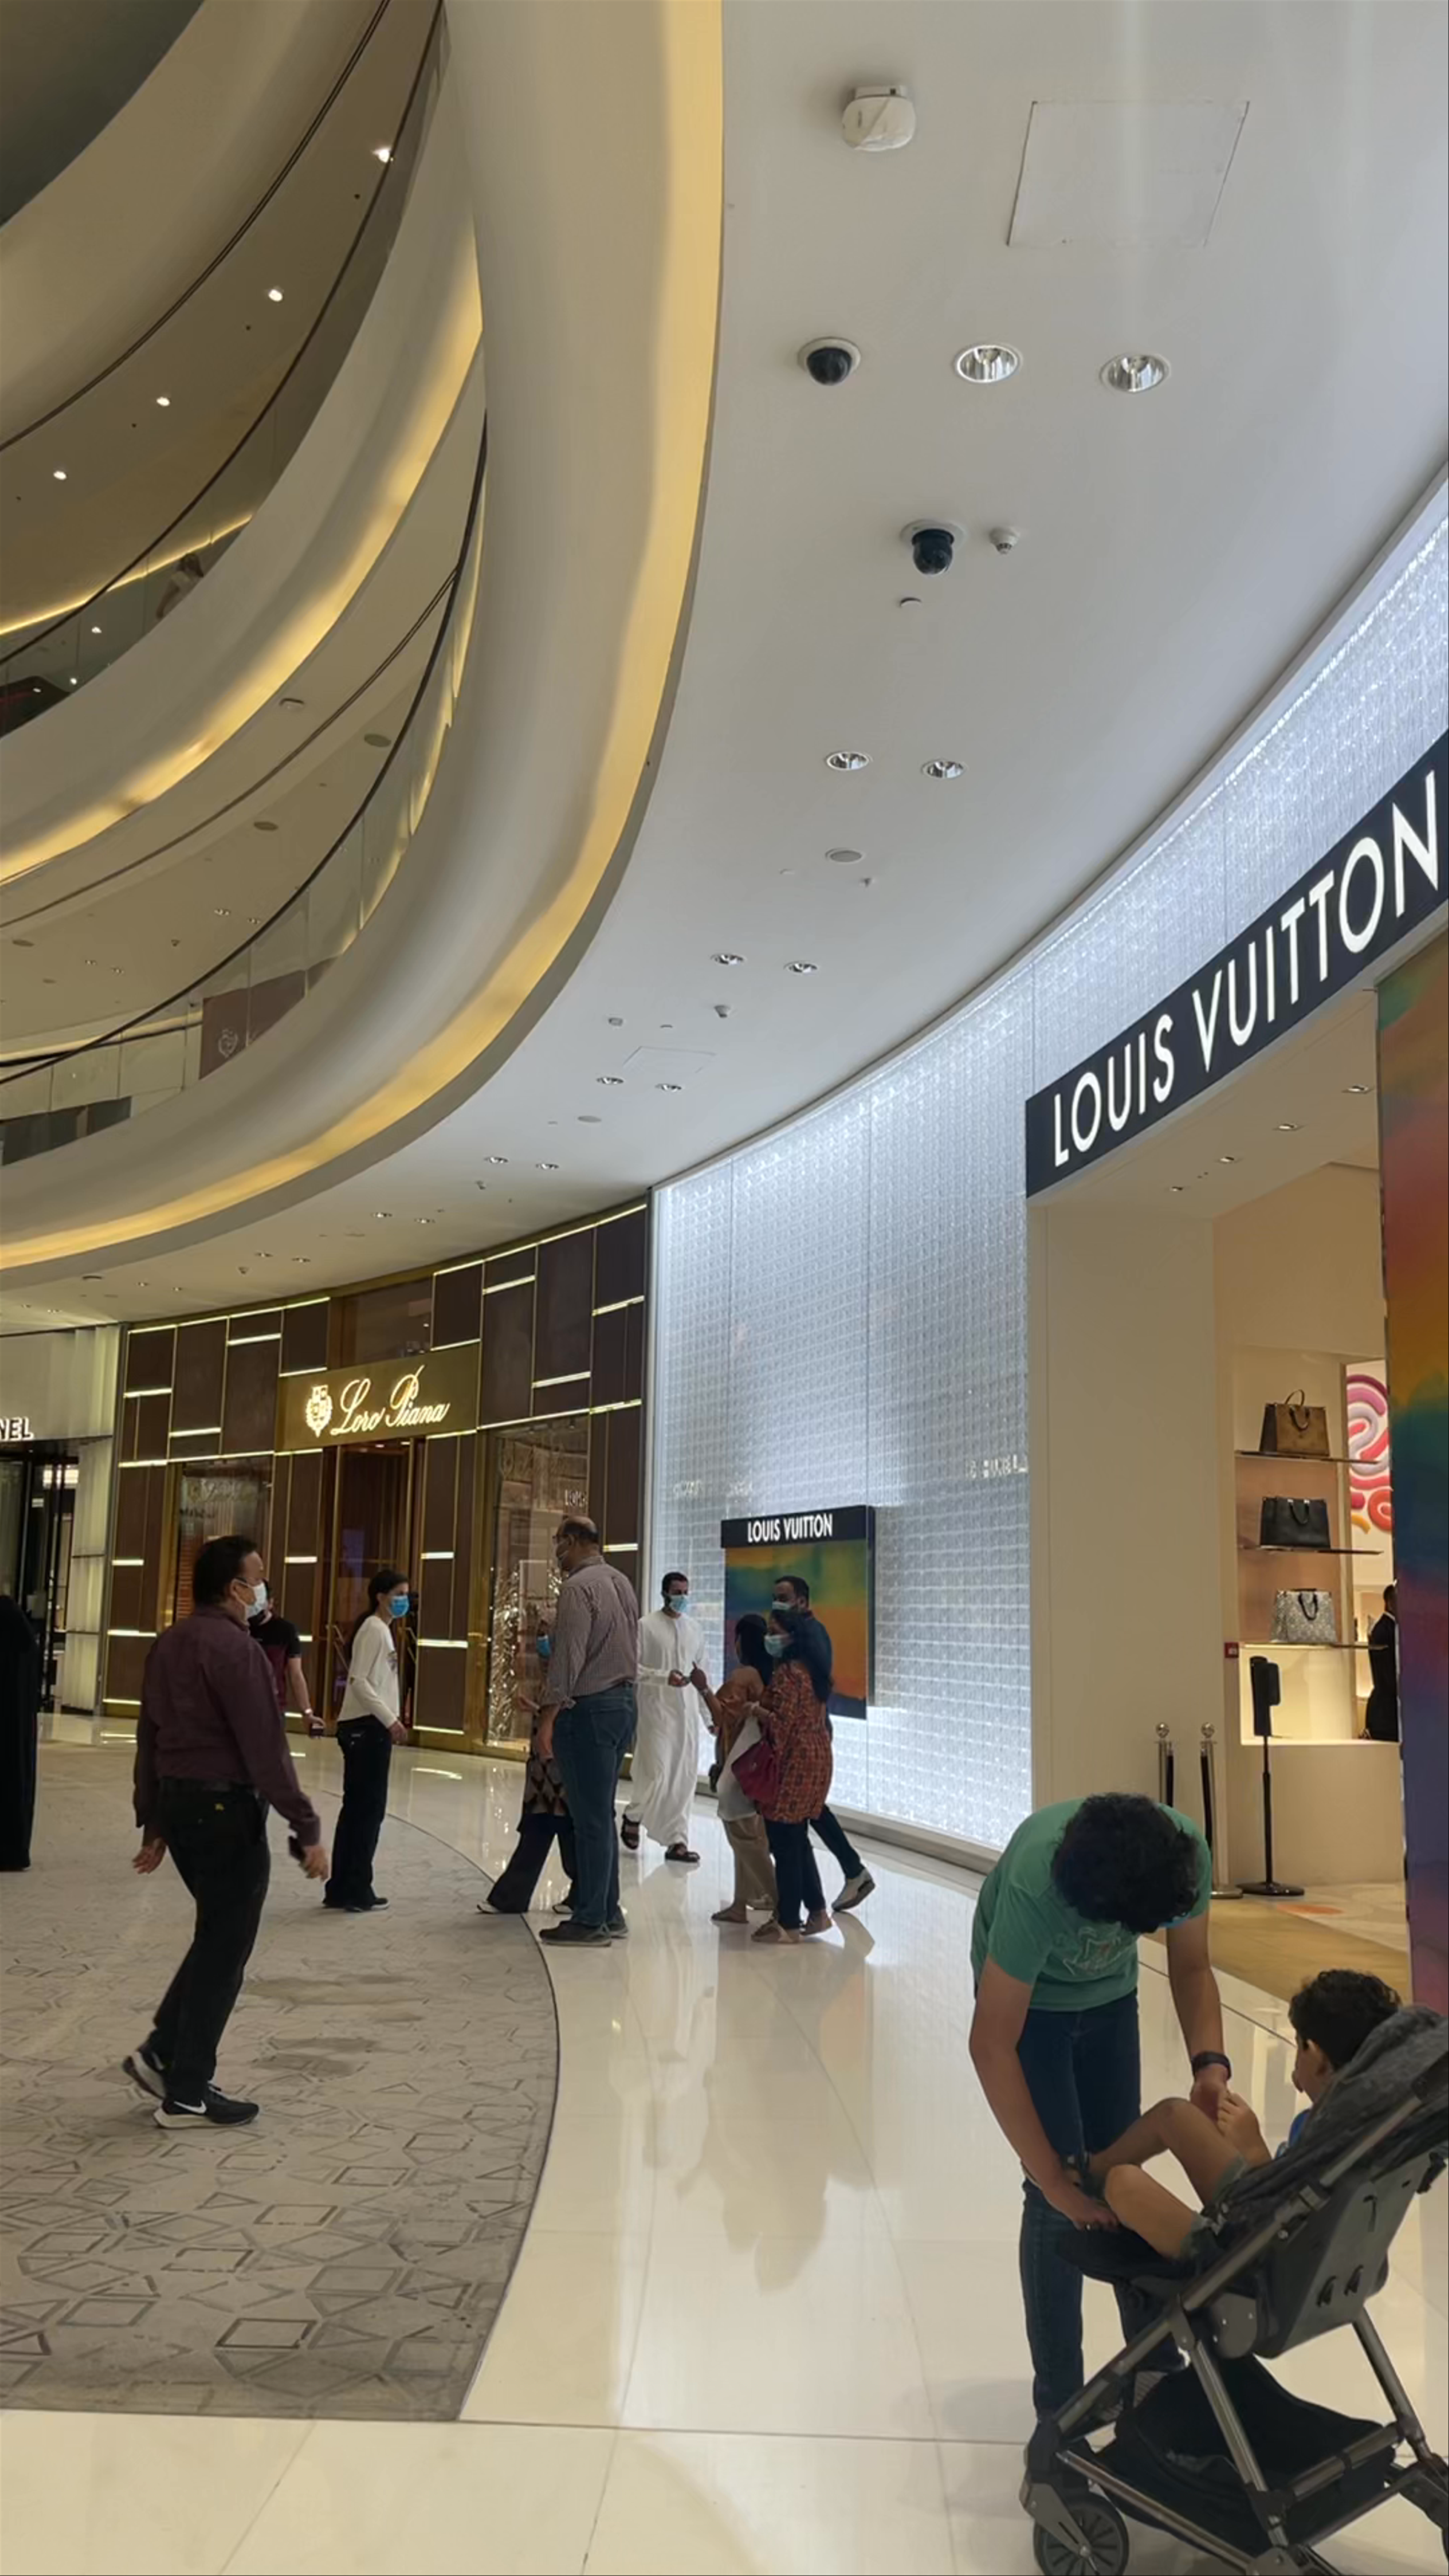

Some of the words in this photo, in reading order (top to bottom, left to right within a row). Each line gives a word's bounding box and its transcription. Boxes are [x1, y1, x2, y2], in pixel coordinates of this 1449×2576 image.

[1054, 1014, 1174, 1167] LOUIS
[1192, 769, 1438, 1073] VUITTON
[330, 1378, 386, 1435] Loro
[386, 1365, 451, 1427] Piana
[748, 1519, 780, 1543] LOUIS
[784, 1513, 833, 1539] VUITTON
